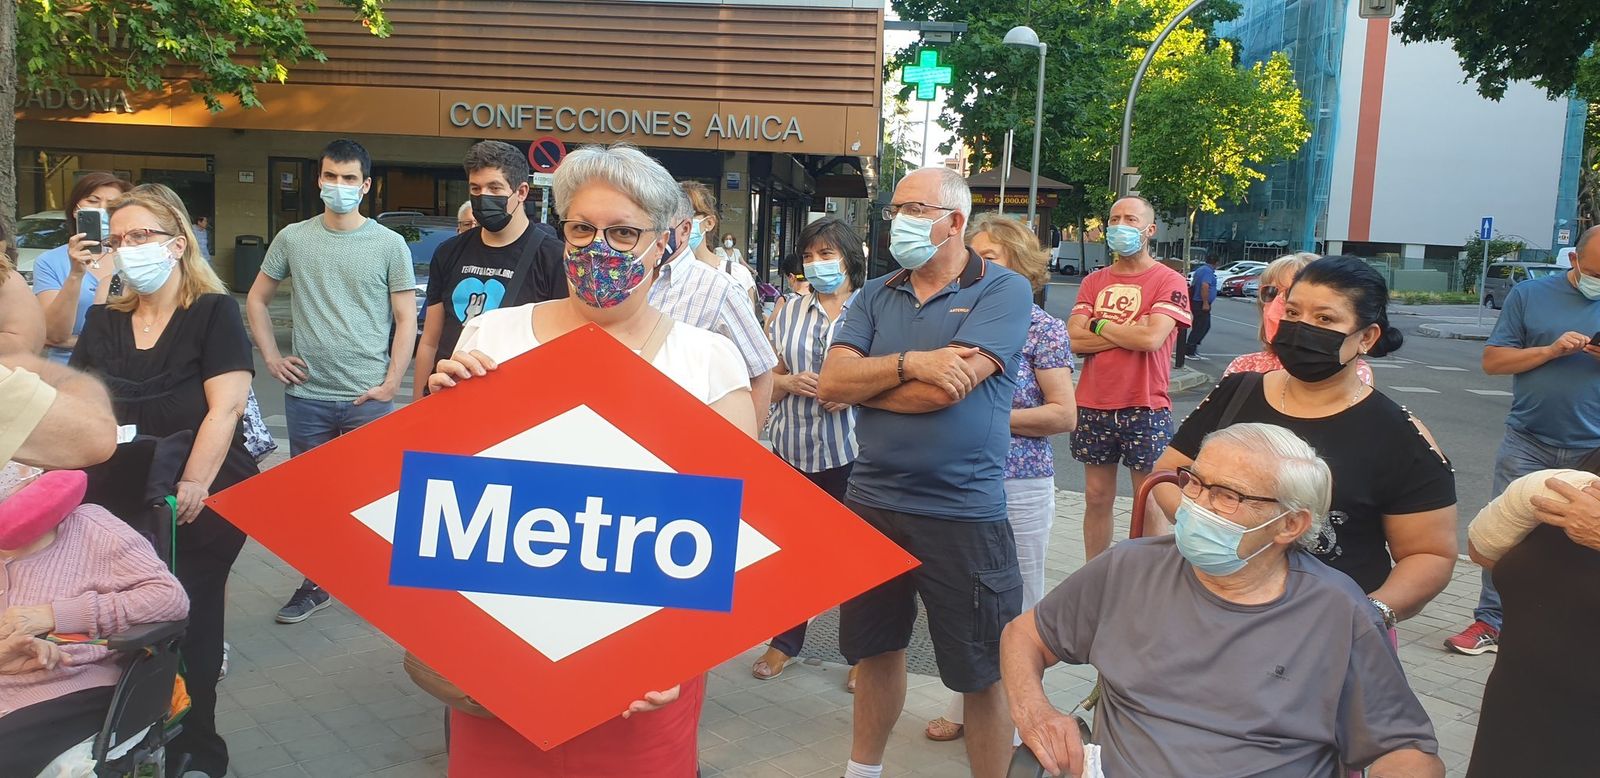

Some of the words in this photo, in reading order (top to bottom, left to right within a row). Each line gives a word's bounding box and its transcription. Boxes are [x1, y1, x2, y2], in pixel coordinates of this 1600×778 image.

[449, 102, 692, 136] CONFECCIONES
[704, 113, 804, 142] AMICA
[418, 478, 713, 580] Metro
